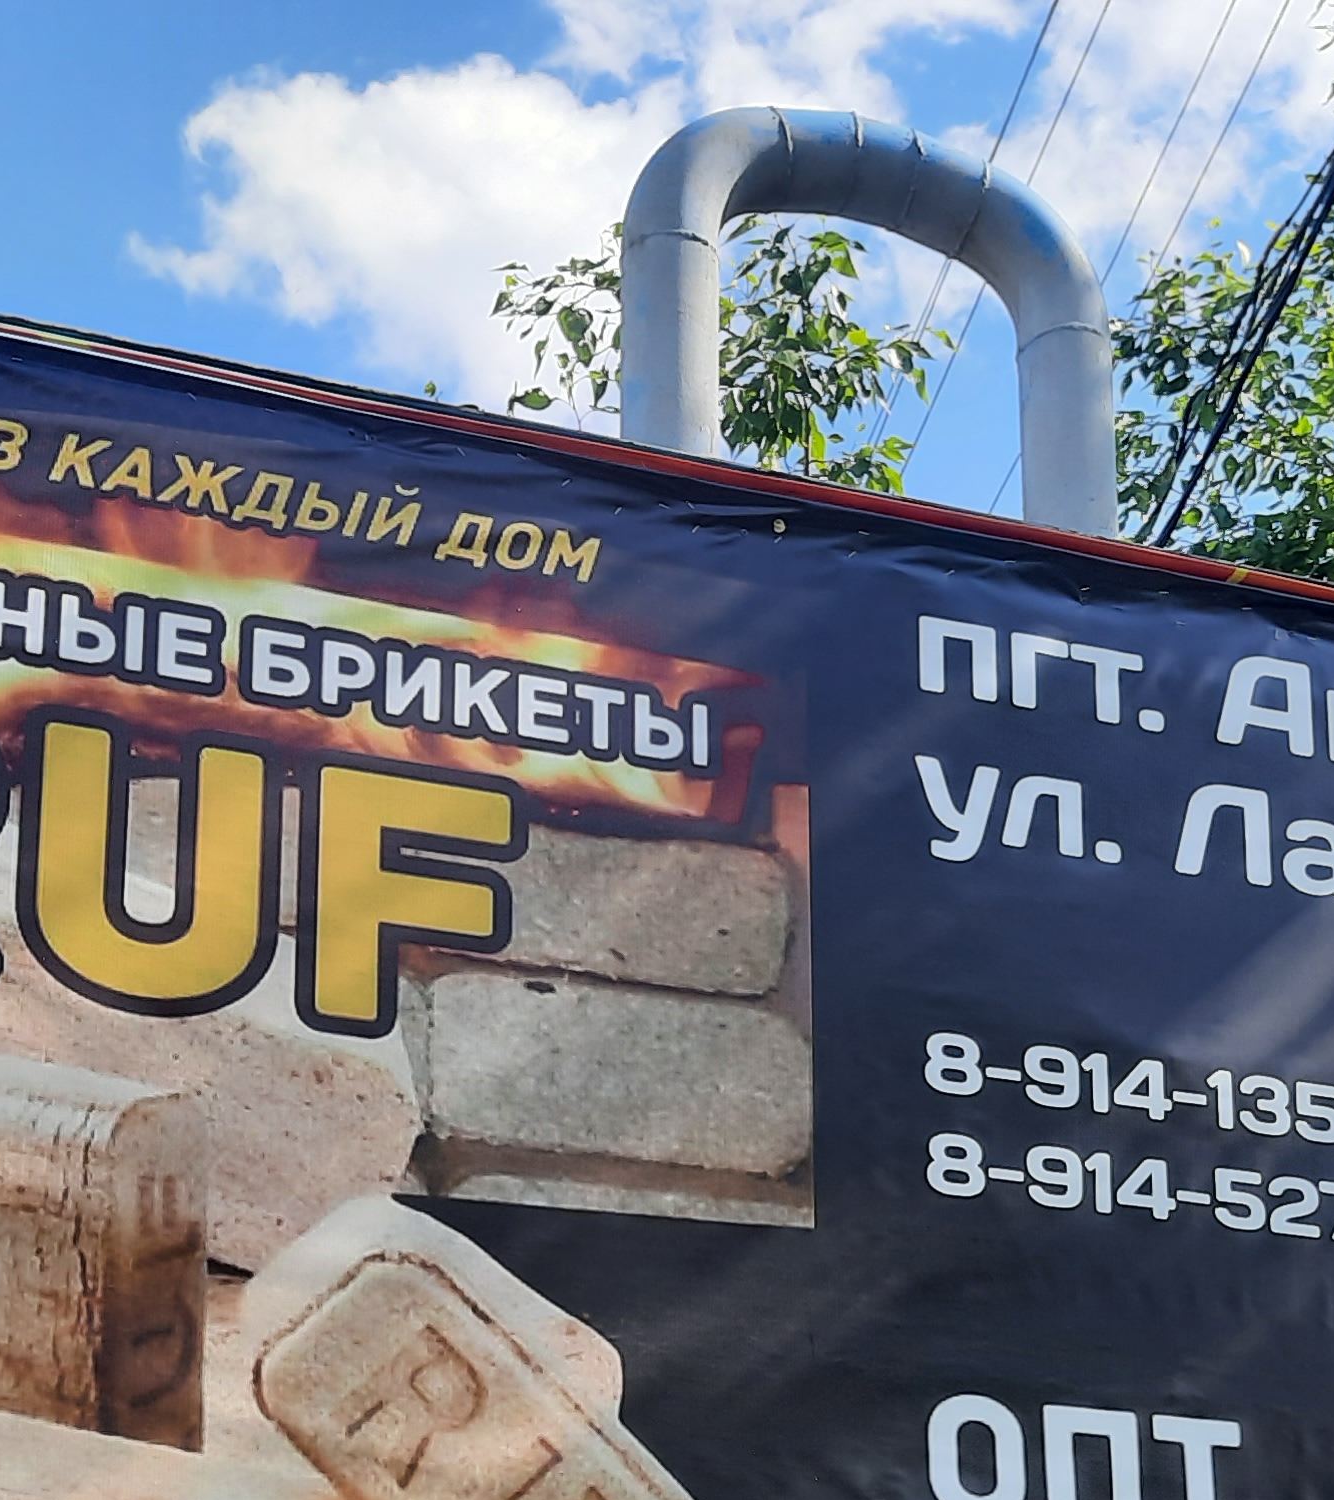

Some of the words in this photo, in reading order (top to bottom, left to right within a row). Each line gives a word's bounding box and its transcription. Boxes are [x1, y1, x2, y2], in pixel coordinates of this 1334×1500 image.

[50, 431, 424, 543] КАЖДЫЙ
[435, 511, 602, 587] ДОМ
[250, 626, 709, 769] БРИКЕТЫ
[918, 614, 1166, 733] пгт.
[913, 754, 1123, 865] ул.
